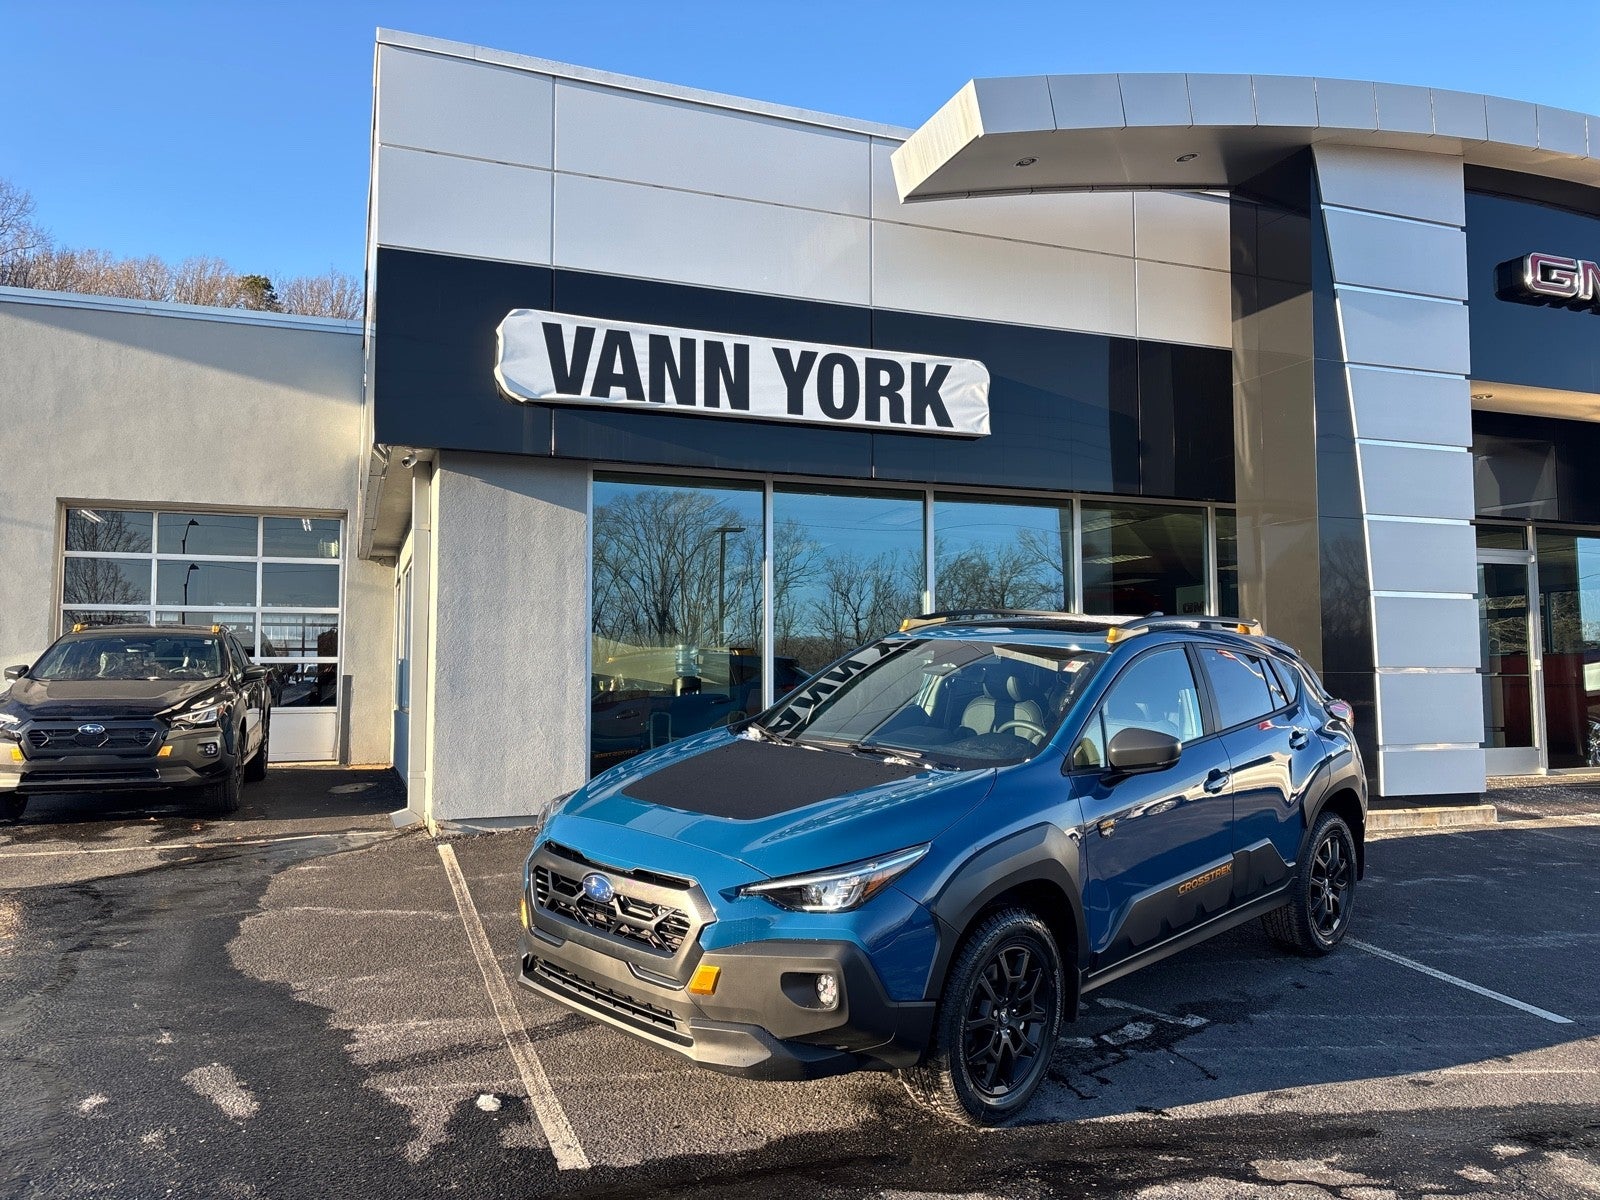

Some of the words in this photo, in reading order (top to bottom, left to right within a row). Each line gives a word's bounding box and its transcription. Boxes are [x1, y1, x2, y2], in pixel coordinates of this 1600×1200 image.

[541, 322, 750, 411] VANN
[772, 347, 953, 427] YORK
[1178, 863, 1233, 894] CROSSTREK
